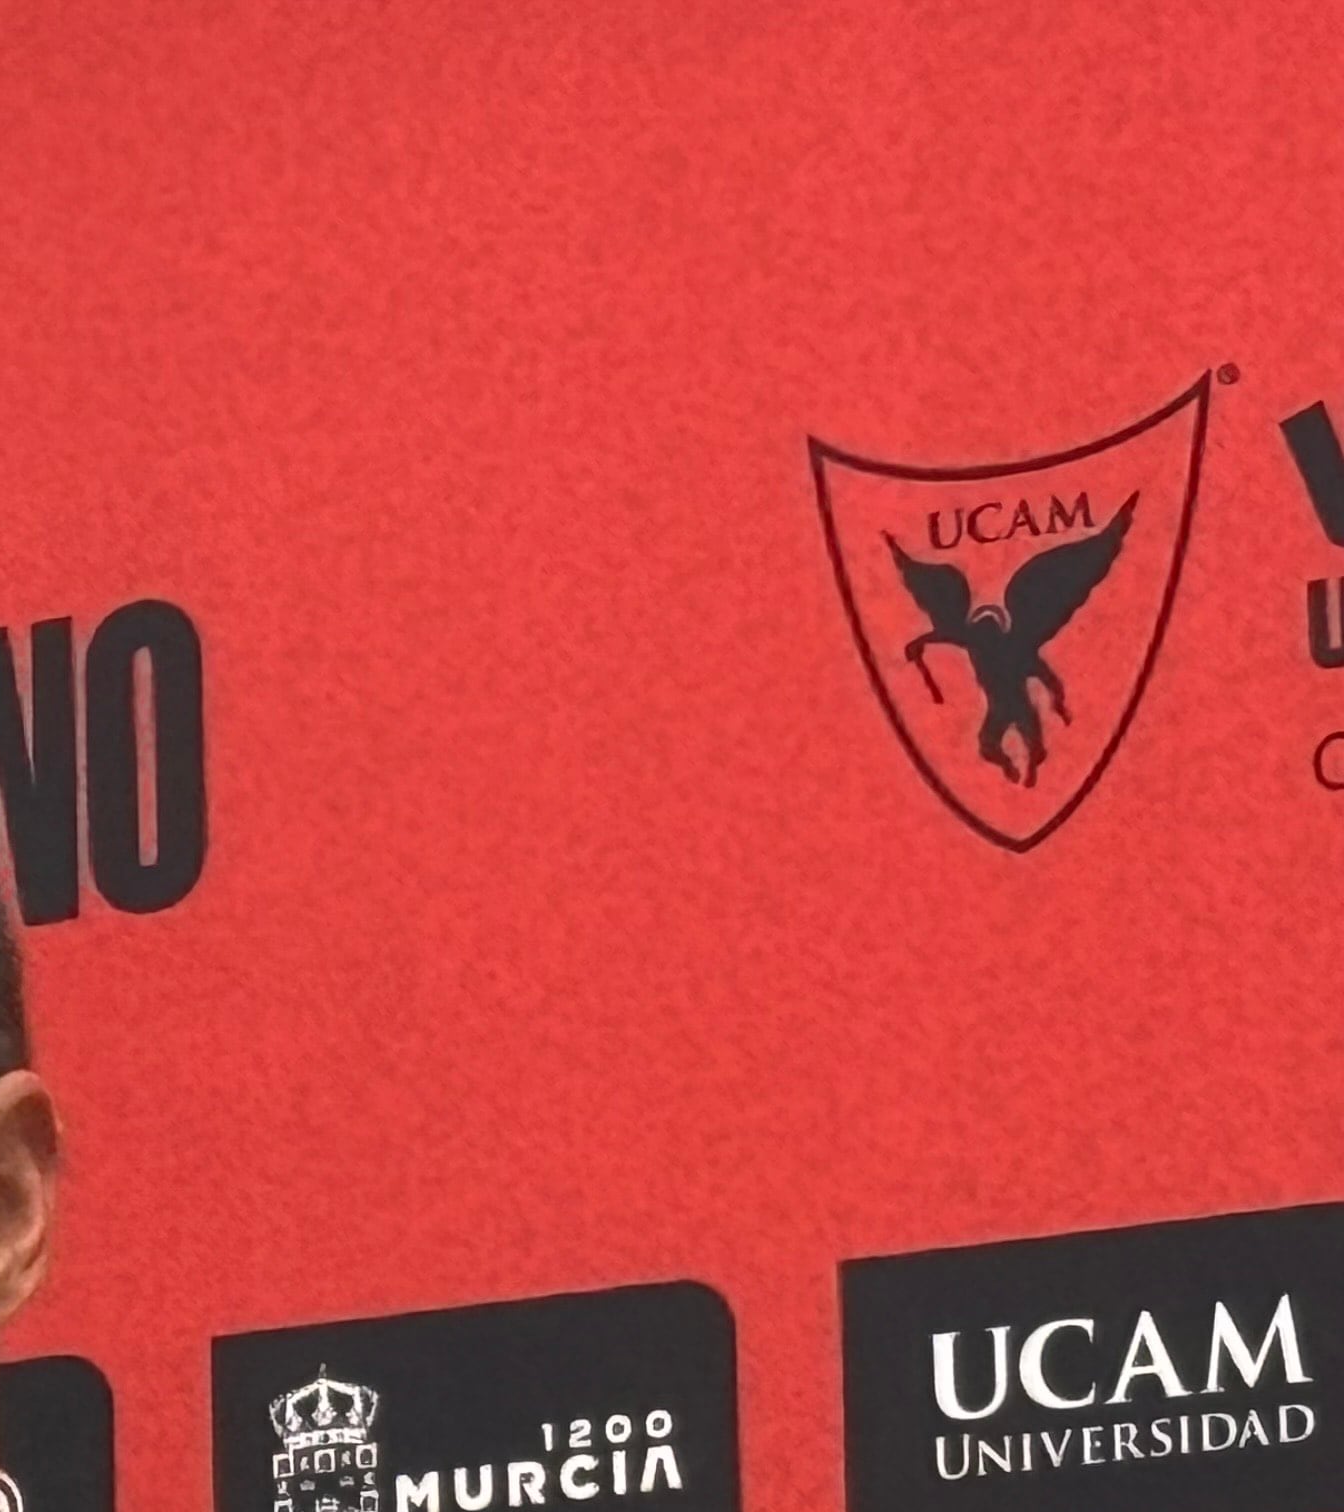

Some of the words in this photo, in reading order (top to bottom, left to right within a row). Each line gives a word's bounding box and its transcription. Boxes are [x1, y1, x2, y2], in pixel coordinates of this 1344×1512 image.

[928, 491, 1095, 550] UCAM
[932, 1292, 1313, 1420] UCAM
[541, 1409, 675, 1452] 1200
[936, 1404, 1316, 1481] UNIVERSIDAD
